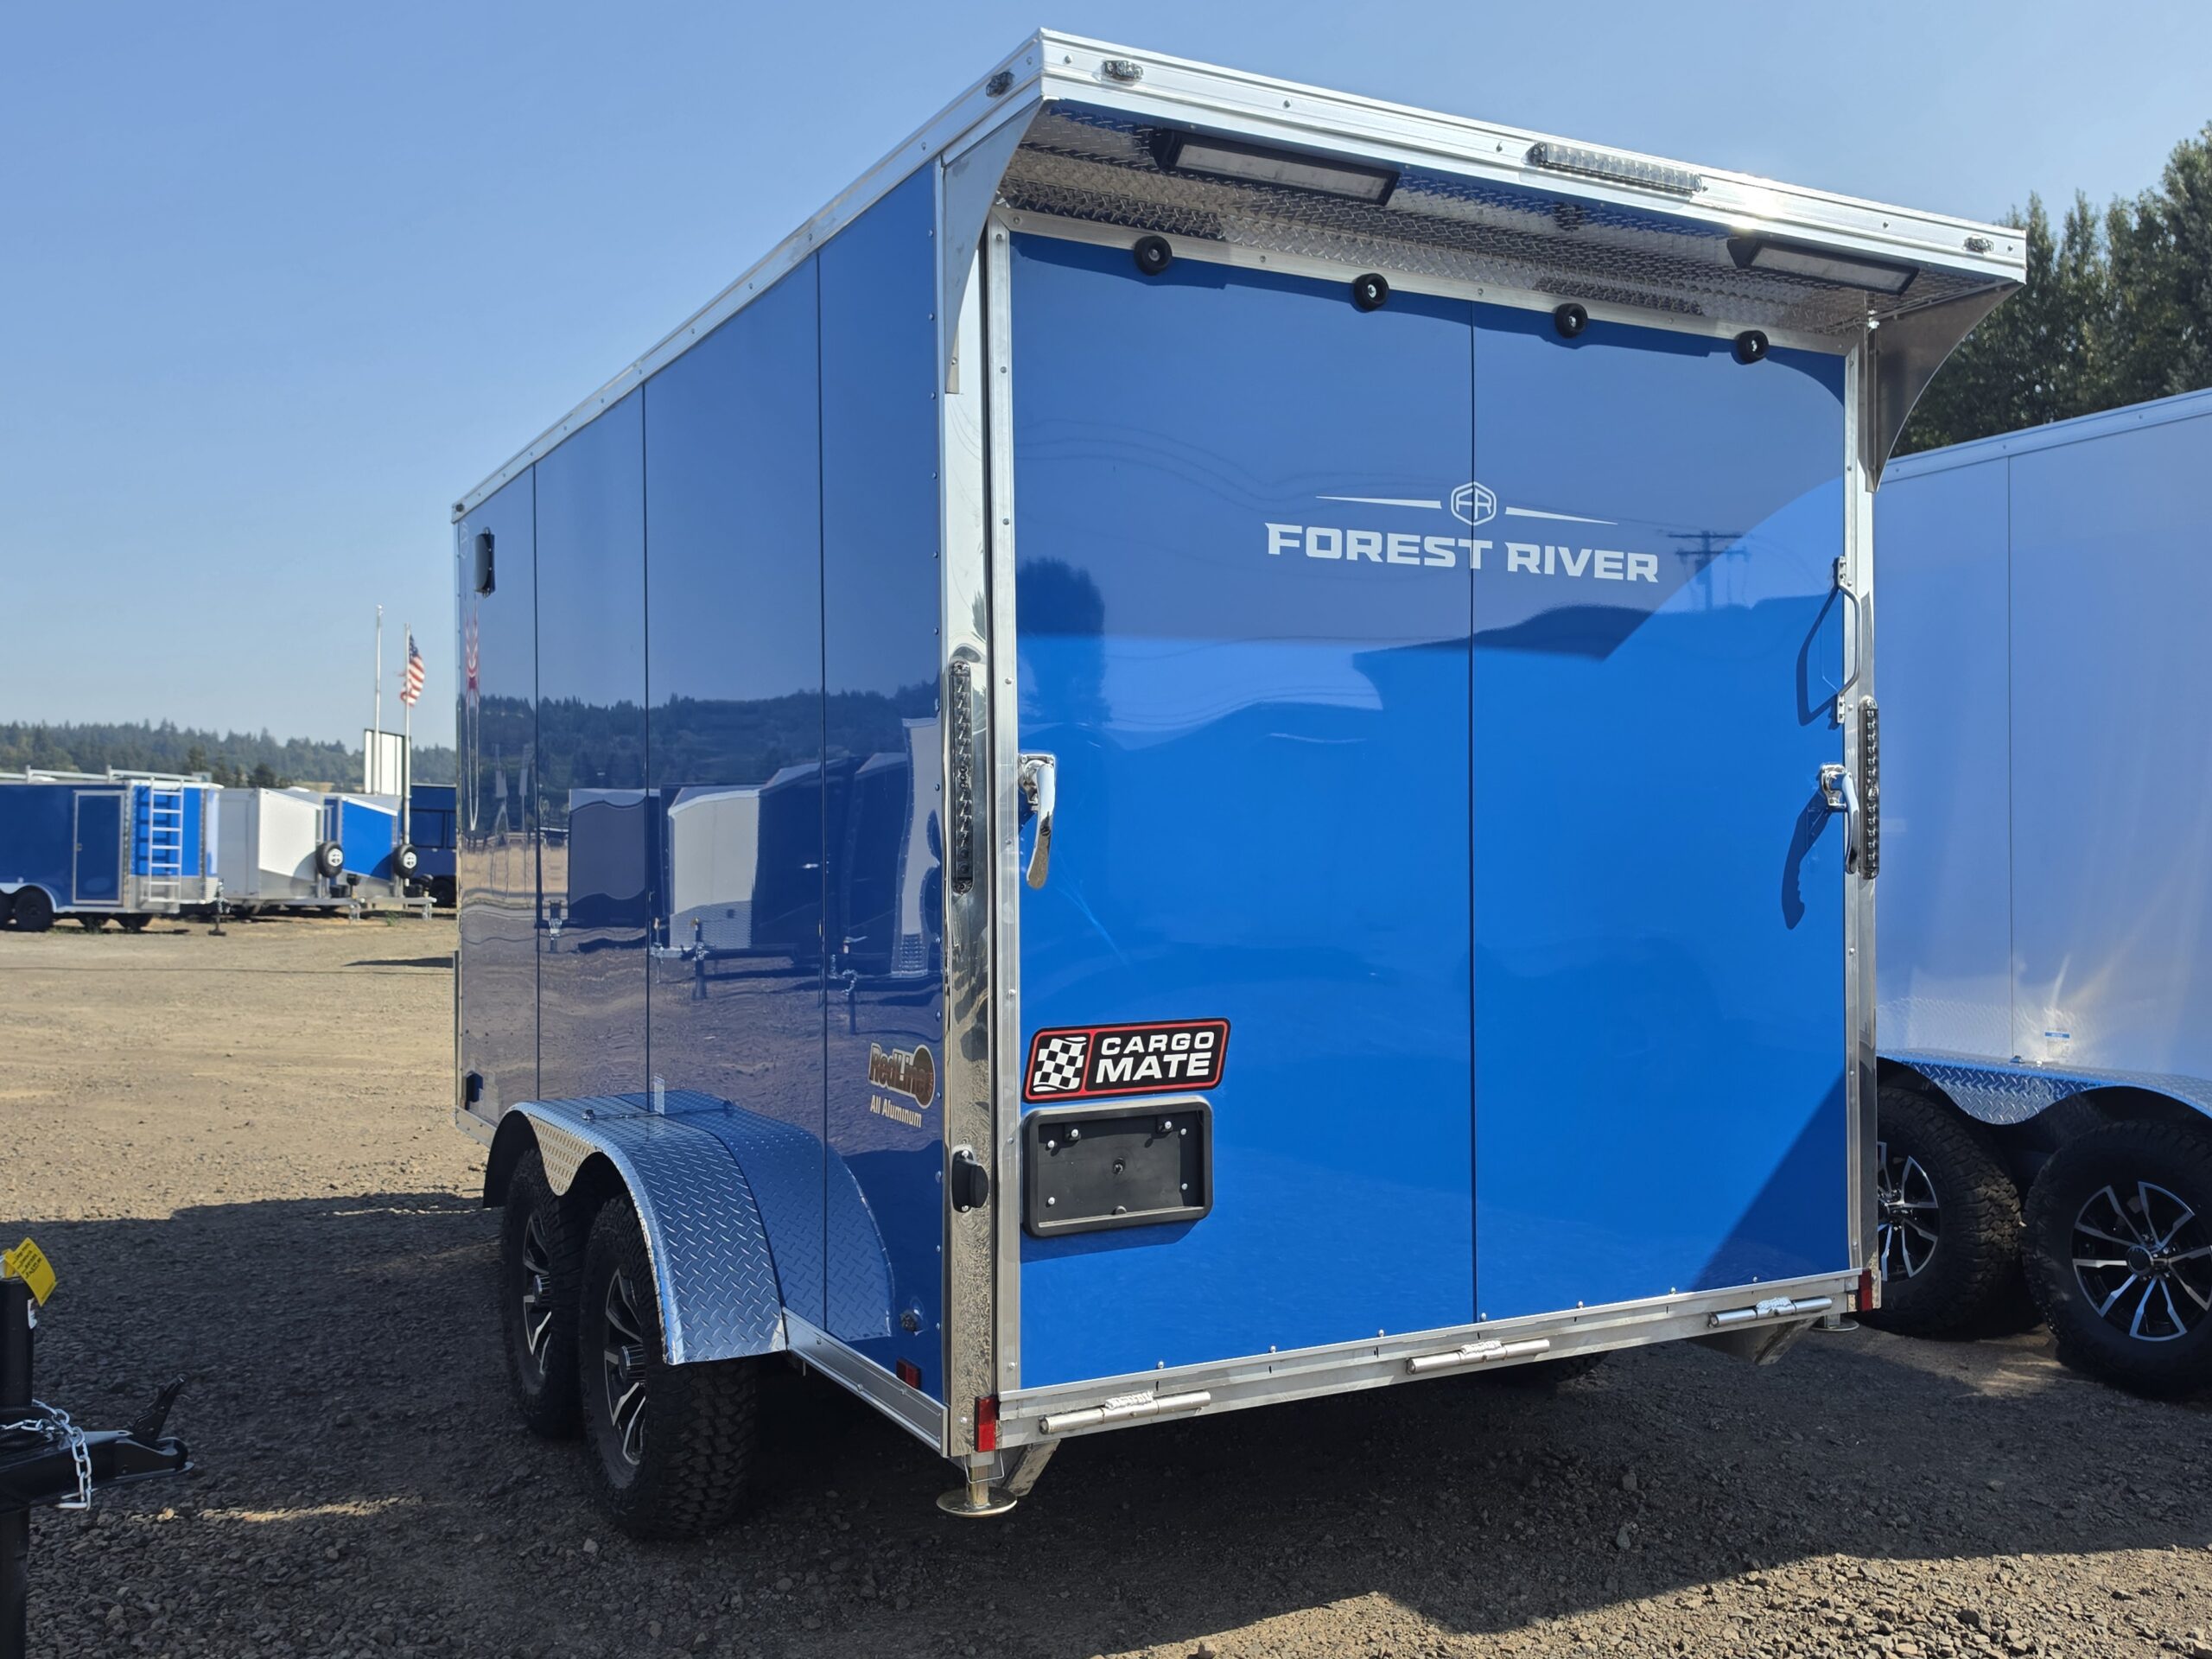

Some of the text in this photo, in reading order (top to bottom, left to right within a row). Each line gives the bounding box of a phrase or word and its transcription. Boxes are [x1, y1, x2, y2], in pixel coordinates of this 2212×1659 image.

[1265, 523, 1658, 583] FOREST RIVER
[1101, 1031, 1215, 1056] CARGO
[1096, 1052, 1212, 1084] MATE
[870, 1094, 922, 1128] All Aluminum
